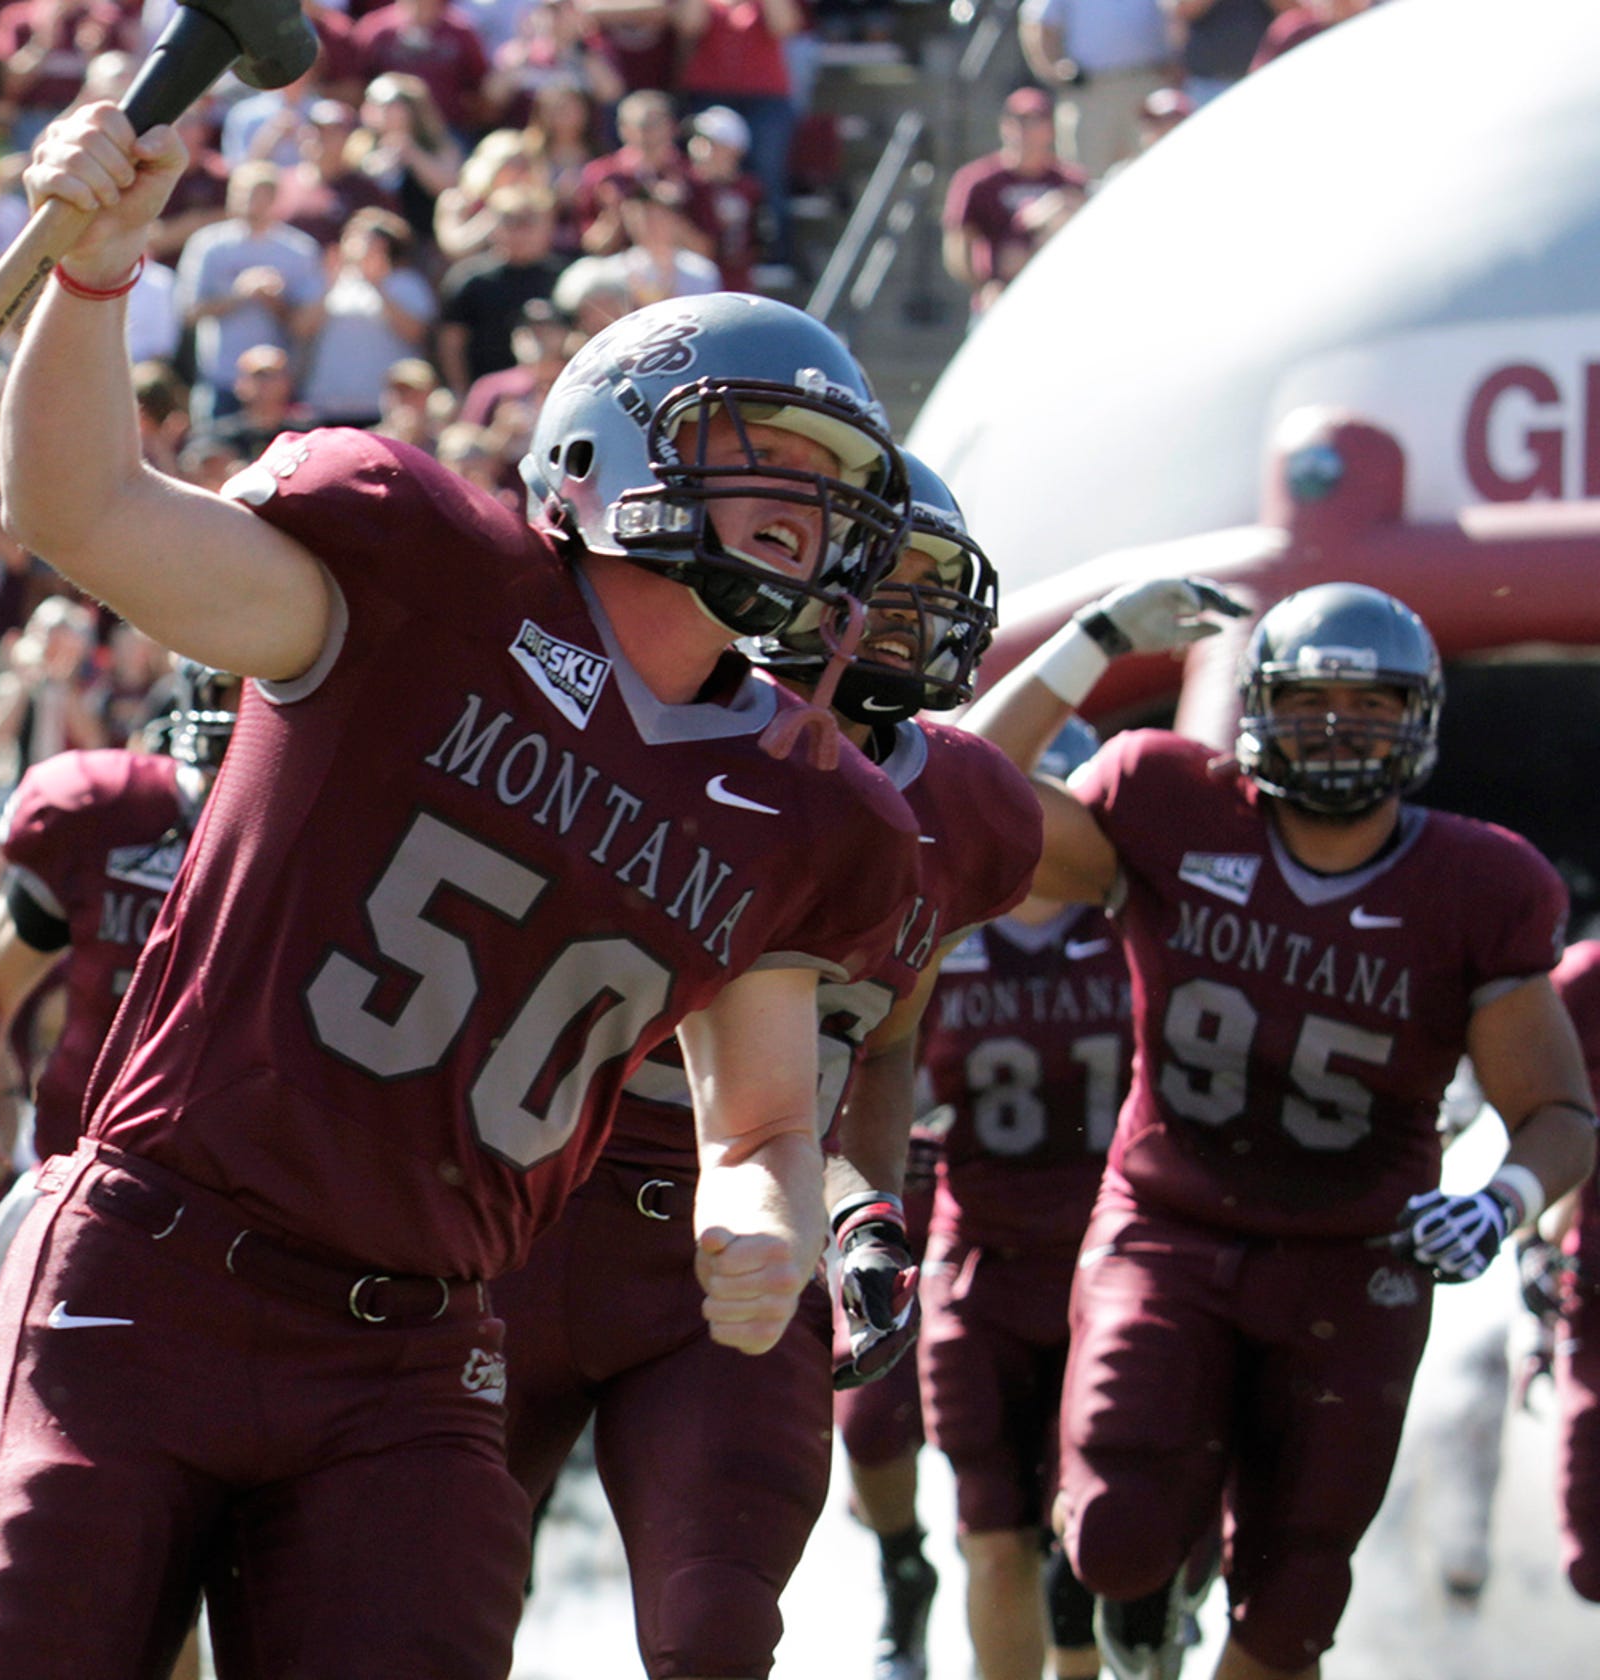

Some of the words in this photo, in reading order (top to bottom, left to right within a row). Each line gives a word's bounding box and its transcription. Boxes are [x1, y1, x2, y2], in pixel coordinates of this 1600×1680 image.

[426, 694, 756, 967] MONTANA
[305, 807, 677, 1174] 50
[1166, 901, 1412, 1020] MONTANA
[966, 1036, 1122, 1154] 81
[1159, 977, 1396, 1154] 95
